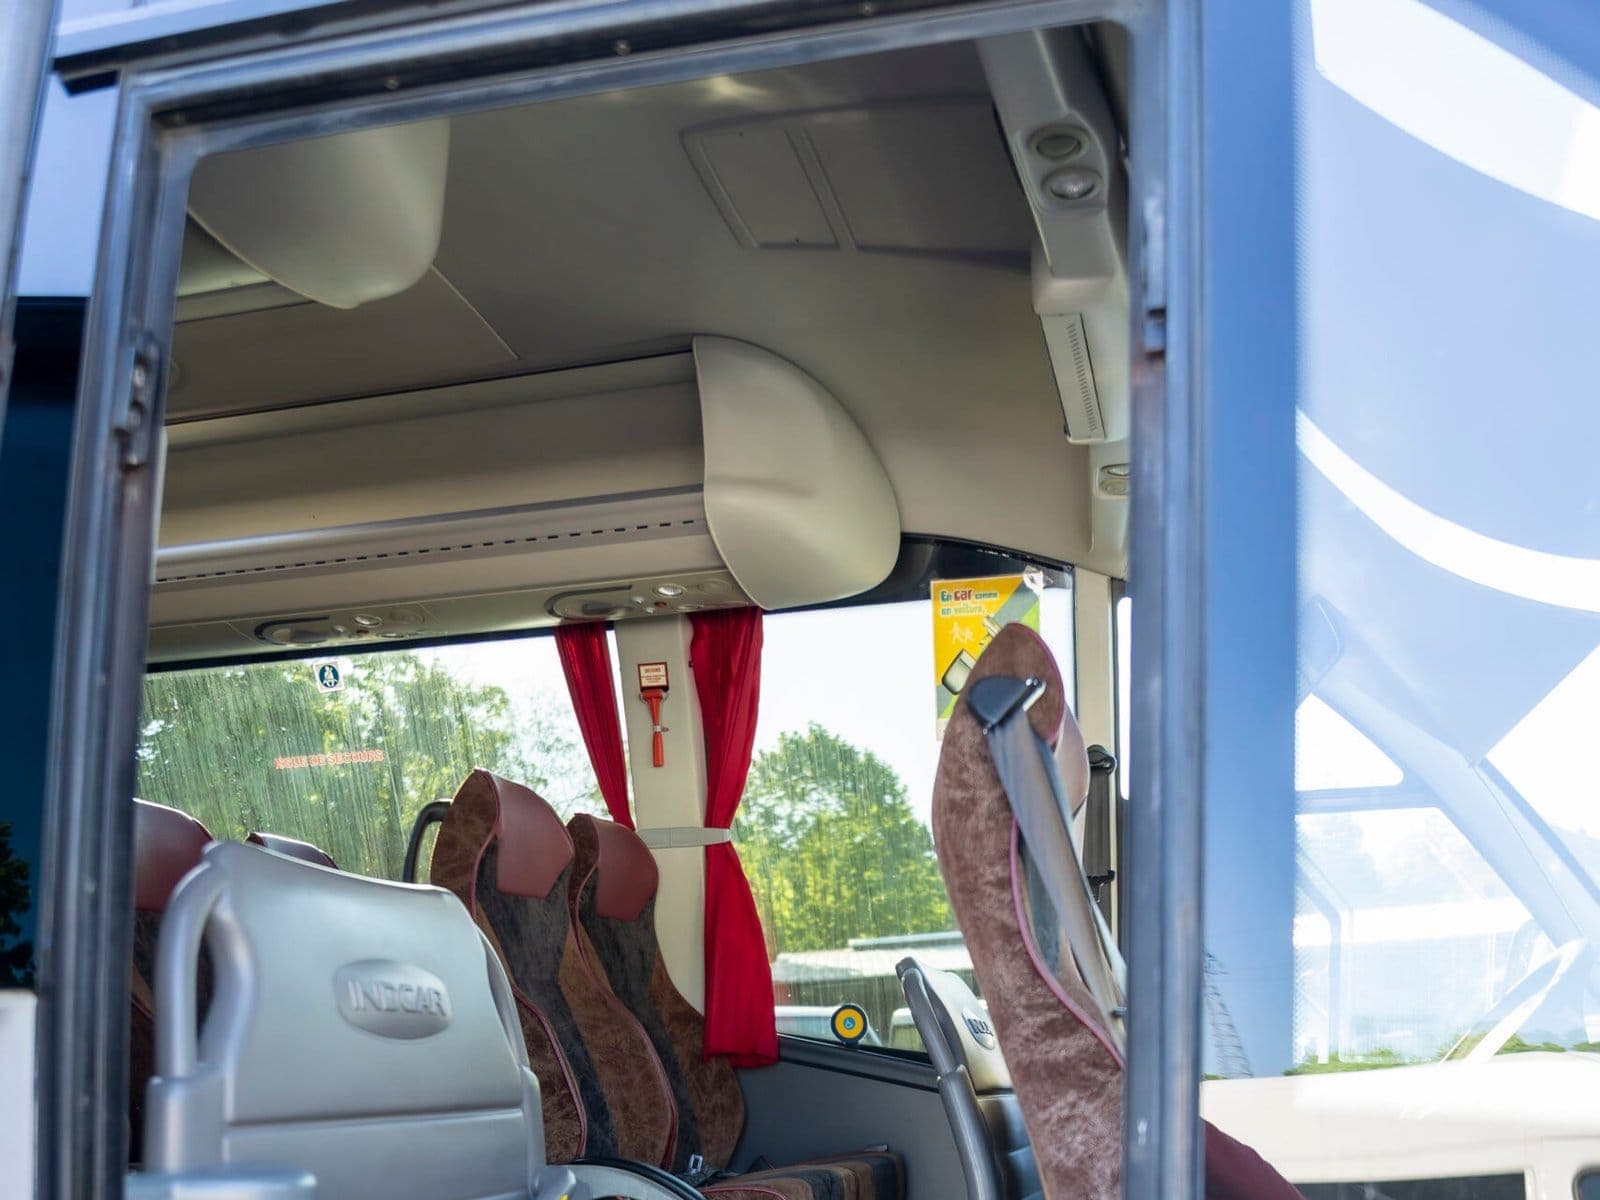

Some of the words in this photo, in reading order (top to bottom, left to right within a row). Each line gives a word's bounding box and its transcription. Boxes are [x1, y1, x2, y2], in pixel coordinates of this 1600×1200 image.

[941, 591, 952, 602] En
[954, 590, 973, 601] car
[309, 755, 326, 766] DE
[327, 750, 384, 765] SECOURS
